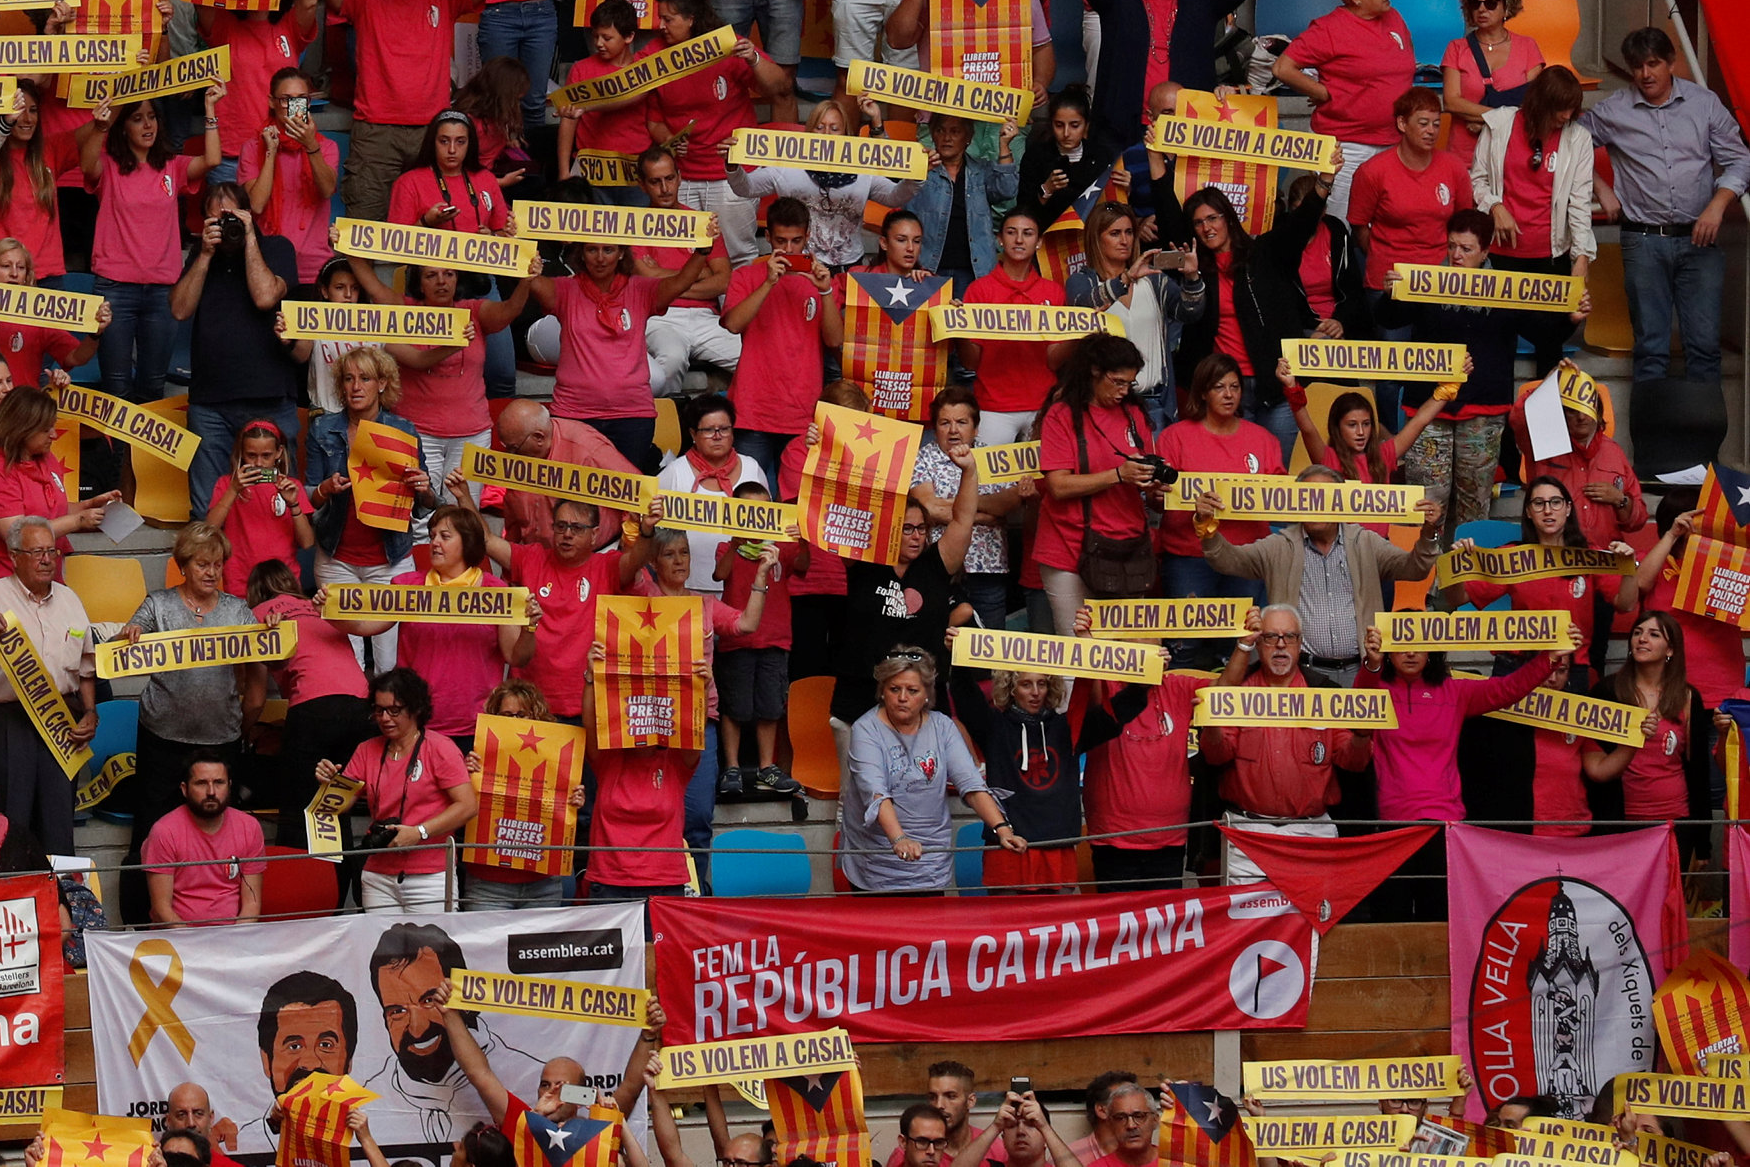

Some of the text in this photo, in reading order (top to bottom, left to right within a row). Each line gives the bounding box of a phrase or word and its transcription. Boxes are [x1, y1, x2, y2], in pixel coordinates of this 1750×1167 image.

[350, 224, 519, 267] US VOLEM A CASA!
[1231, 486, 1405, 513] US VOLEM A CASA!
[339, 588, 512, 615] US VOLEM A CASA!
[970, 633, 1145, 673] US VOLEM A CASA!
[628, 696, 672, 706] LLIBERTAT
[629, 705, 672, 718] PRESES
[637, 727, 673, 737] EXILIADES
[518, 943, 614, 960] assemblea.cat
[693, 934, 782, 982] FEM LA
[1482, 921, 1528, 1006] VELLA
[693, 898, 1205, 1043] REPÚBLICA CATALANA
[461, 975, 636, 1018] US VOLEM A CASA!
[1608, 920, 1650, 1061] dels Xiquets de
[584, 1073, 622, 1089] ORDI
[127, 1101, 169, 1118] JORD
